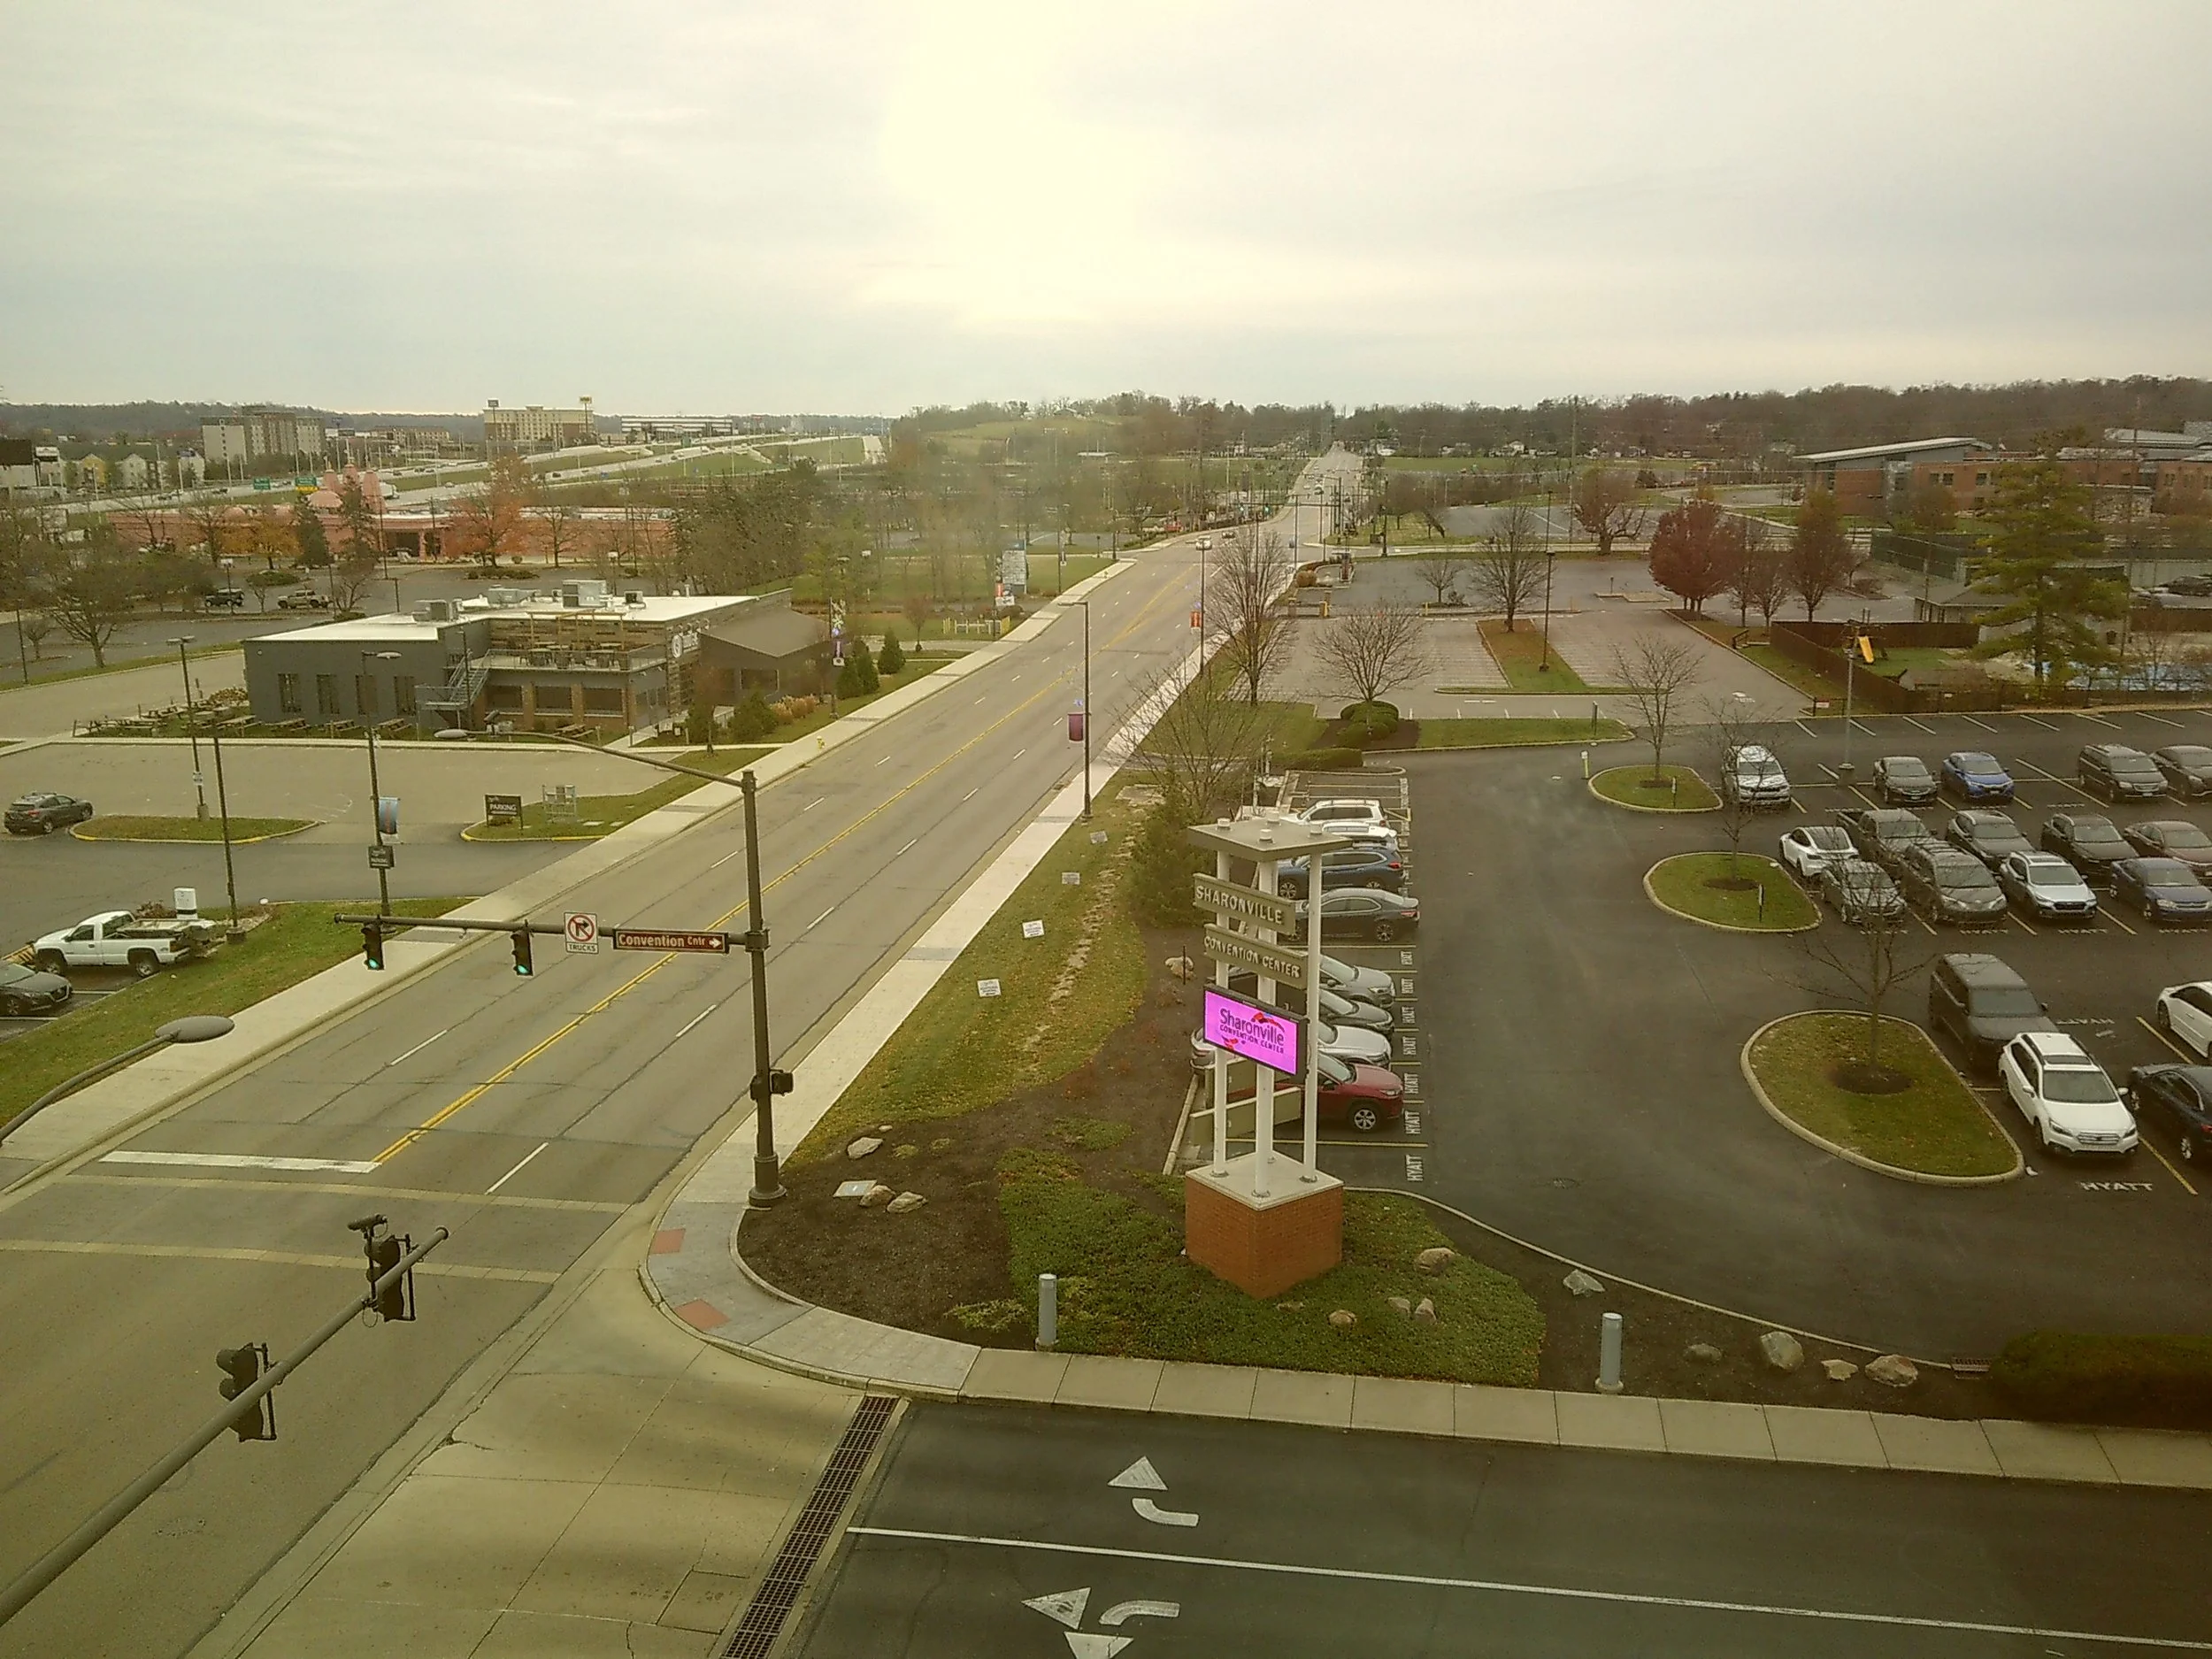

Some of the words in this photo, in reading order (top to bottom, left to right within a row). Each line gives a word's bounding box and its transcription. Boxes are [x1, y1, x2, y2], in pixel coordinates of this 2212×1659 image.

[1194, 885, 1283, 925] SHARONVILLE
[568, 943, 596, 952] TRUCKS
[618, 933, 685, 948] Convention
[687, 934, 706, 946] Cntr
[1203, 935, 1259, 964] CONVENTION
[1262, 955, 1301, 979] CENTER
[1219, 1008, 1285, 1047] Sharonville
[1219, 1024, 1258, 1045] CONVENTION
[1260, 1039, 1285, 1055] CENTER
[1404, 1072, 1419, 1094] HYATT
[1404, 1110, 1421, 1134] HYATT
[1406, 1154, 1424, 1182] HYATT
[2079, 1181, 2153, 1191] HYATT
